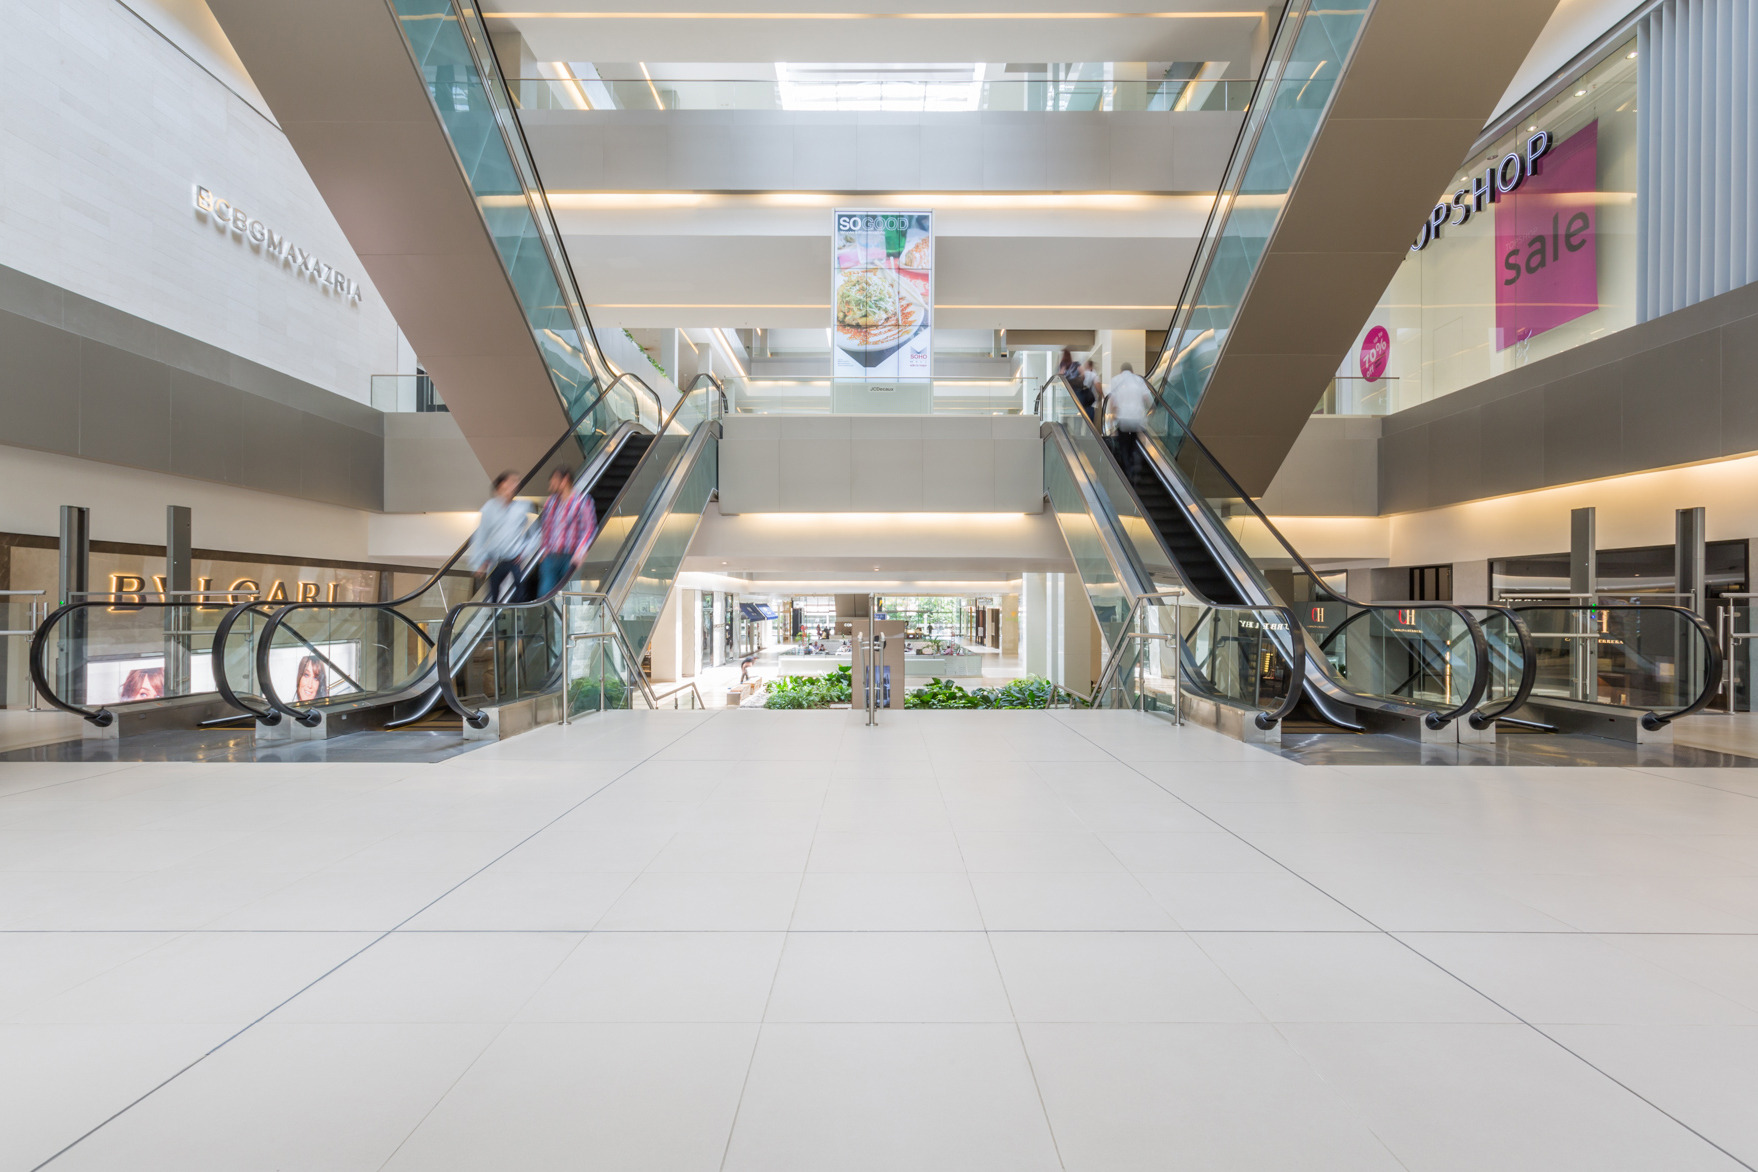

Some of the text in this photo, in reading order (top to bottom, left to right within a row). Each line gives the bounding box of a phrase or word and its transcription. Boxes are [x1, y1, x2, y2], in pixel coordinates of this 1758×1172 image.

[1409, 130, 1553, 252] PSHOP
[195, 184, 363, 302] BCBGMAXAZRIA
[1503, 211, 1591, 286] sale
[1362, 338, 1387, 369] 70%
[1311, 607, 1325, 623] CH
